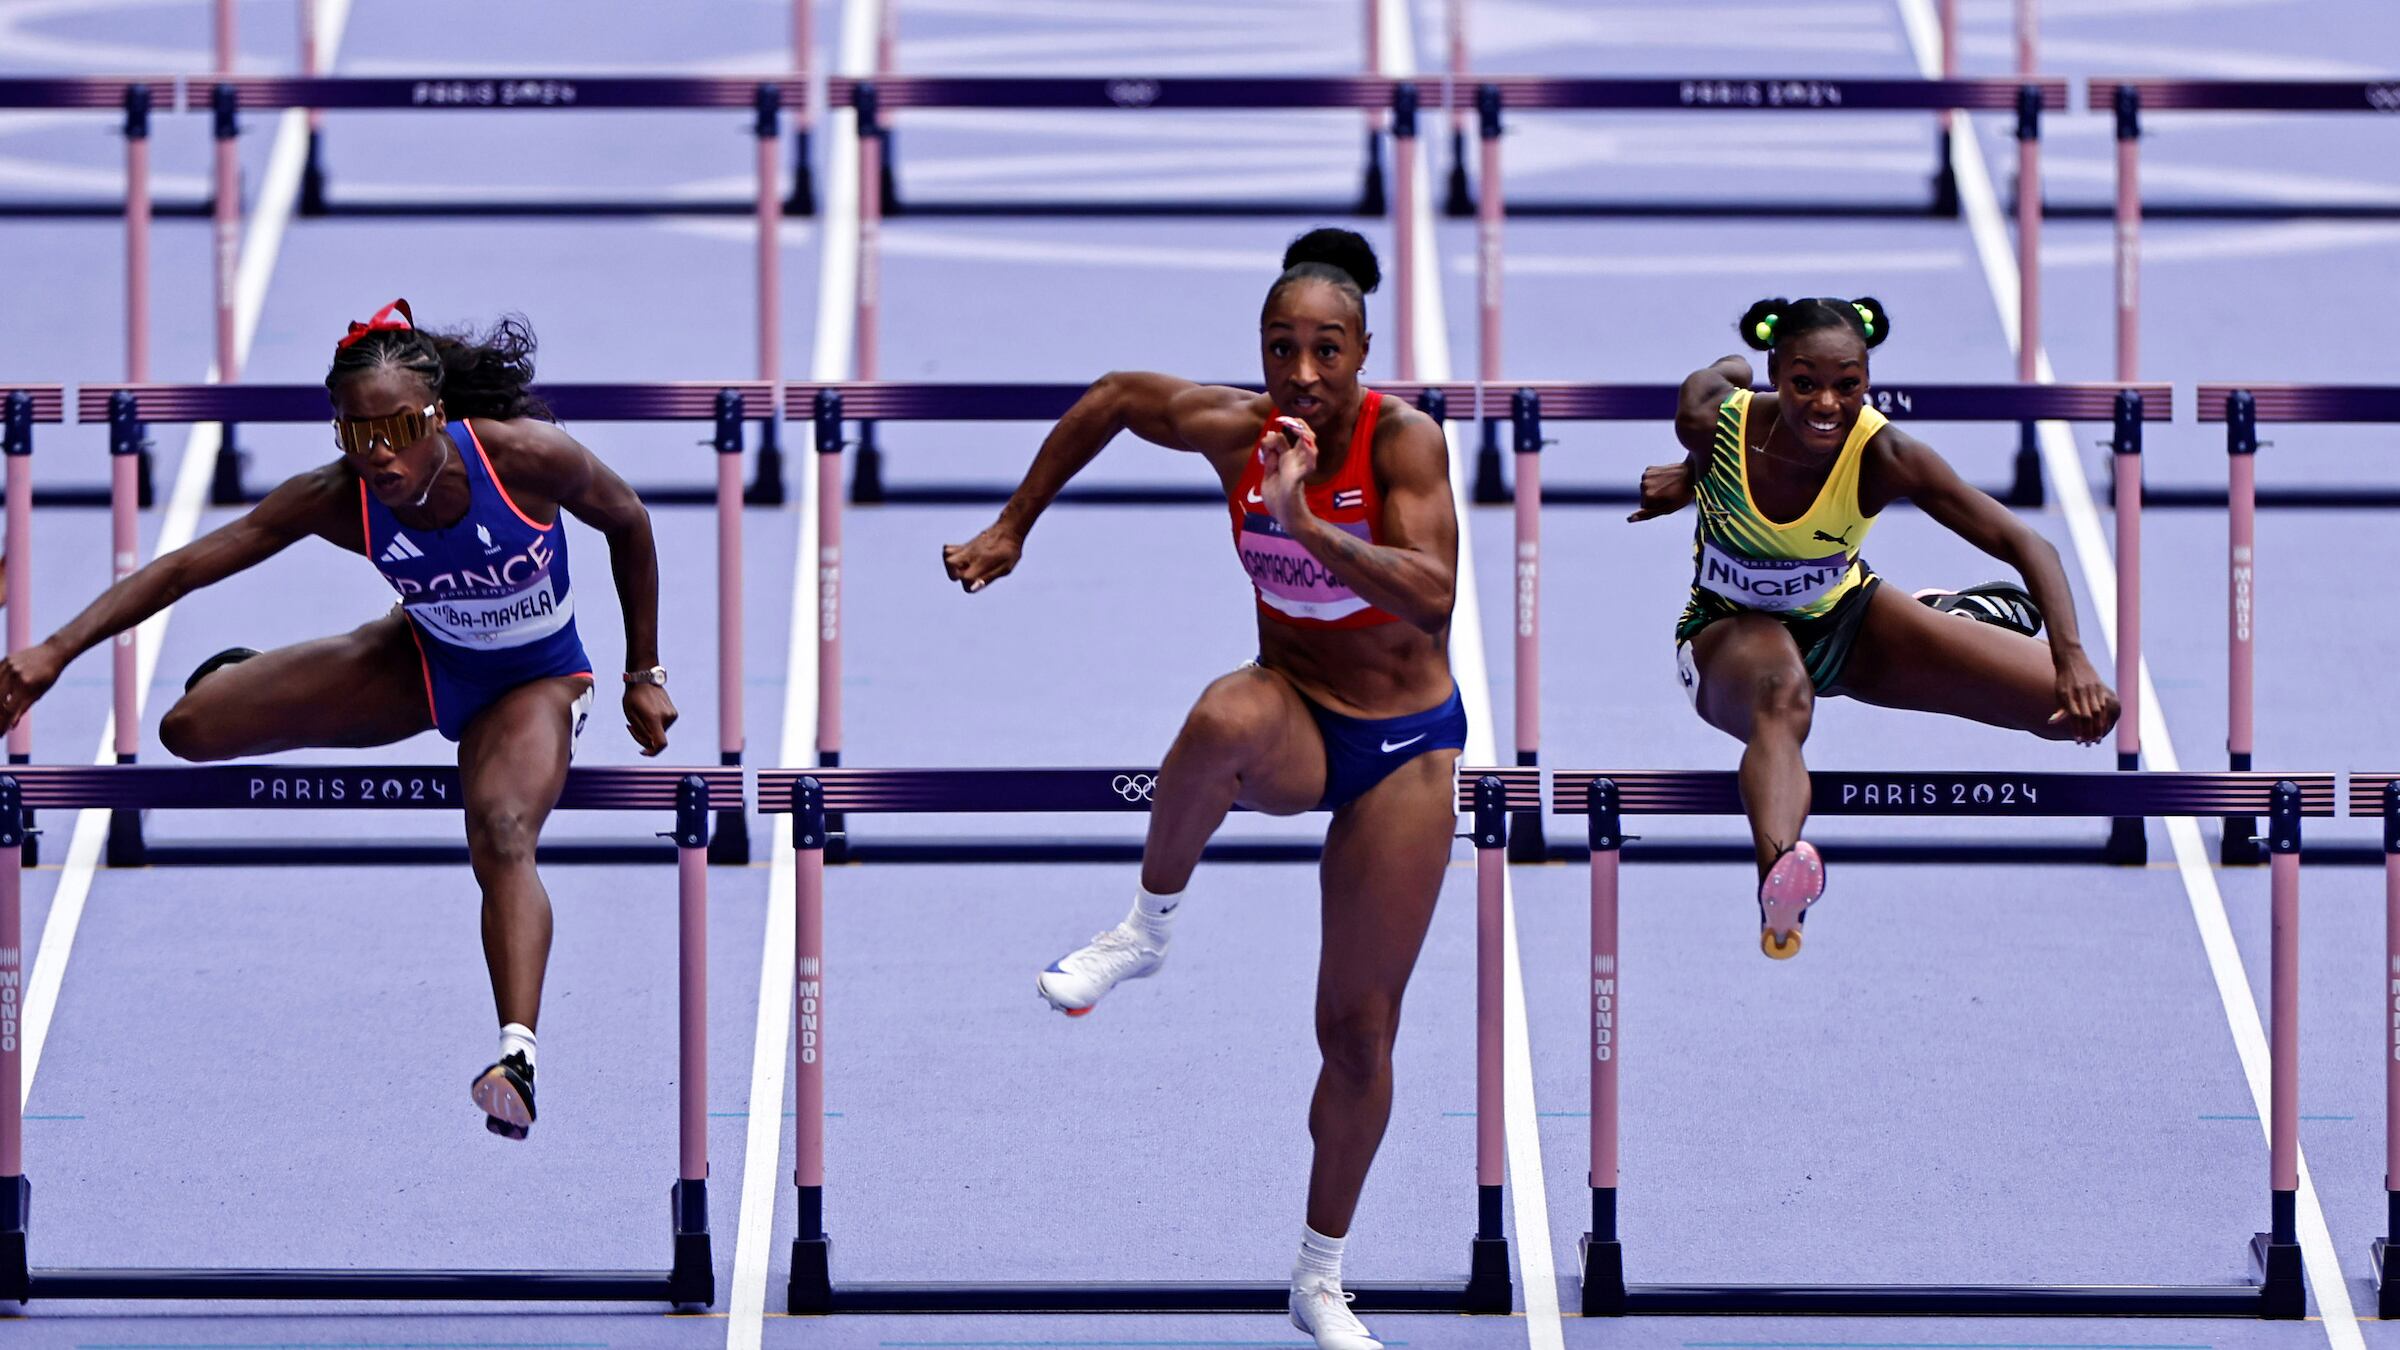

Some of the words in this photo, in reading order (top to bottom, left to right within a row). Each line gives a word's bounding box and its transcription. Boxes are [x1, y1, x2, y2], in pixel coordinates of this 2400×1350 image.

[1708, 557, 1840, 596] NUGENT
[361, 778, 446, 799] 2024
[1951, 783, 2037, 804] 2024
[0, 971, 18, 1052] MONDO
[800, 981, 819, 1063] MONDO
[1595, 979, 1614, 1061] MONDO
